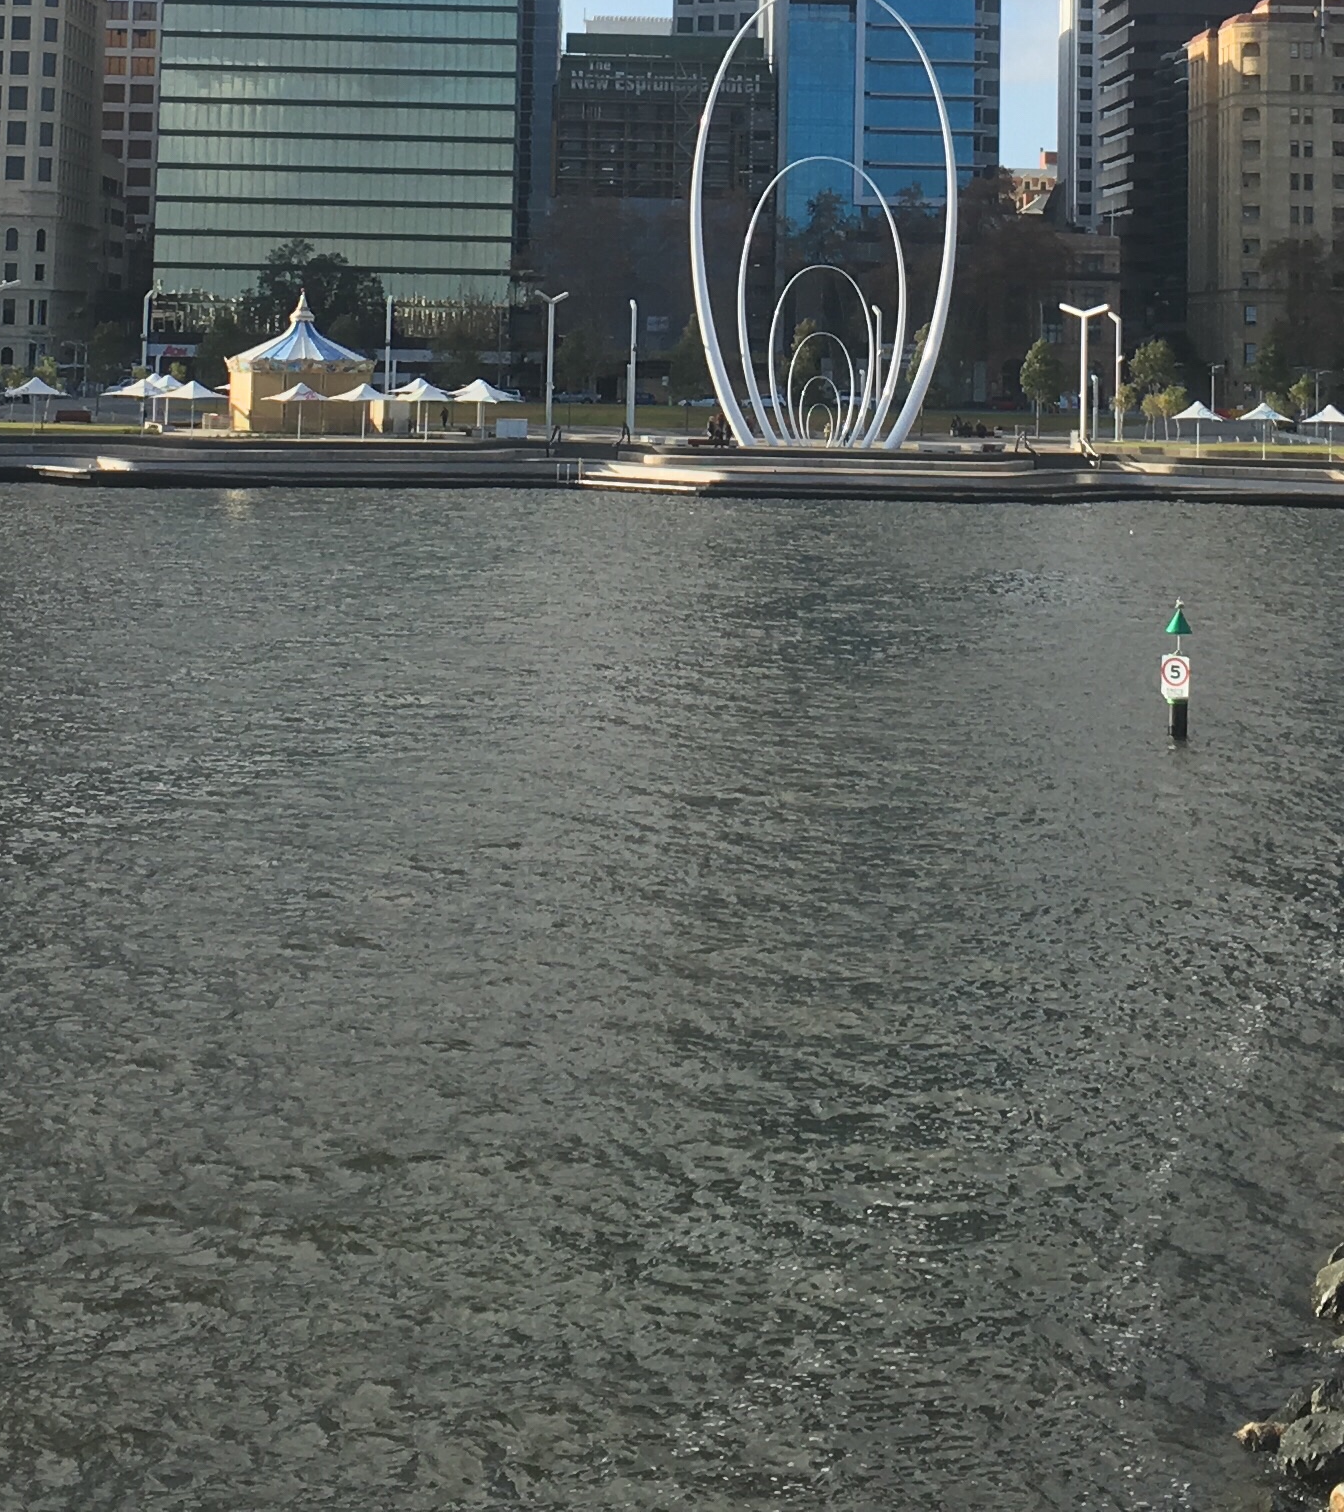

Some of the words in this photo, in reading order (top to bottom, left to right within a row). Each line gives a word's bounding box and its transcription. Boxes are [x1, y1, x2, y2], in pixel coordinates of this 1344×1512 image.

[588, 61, 612, 71] The
[570, 70, 609, 90] New
[1170, 665, 1181, 679] 5
